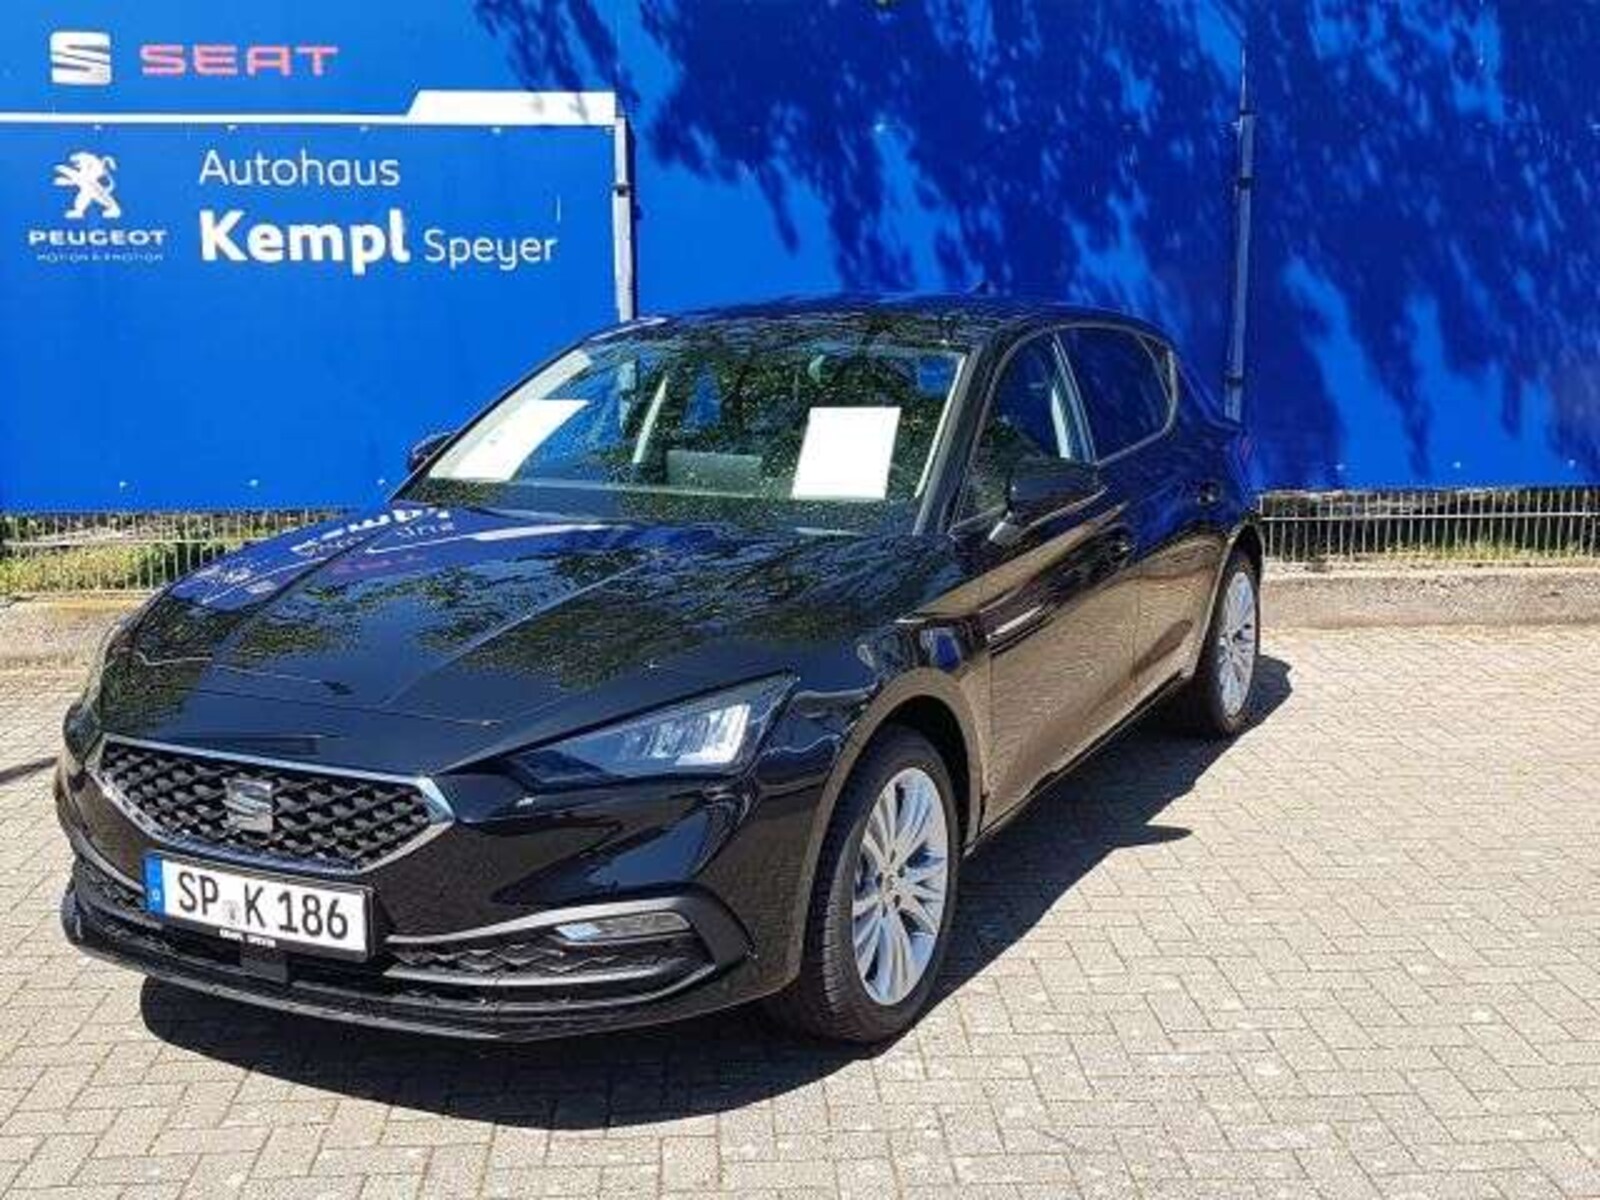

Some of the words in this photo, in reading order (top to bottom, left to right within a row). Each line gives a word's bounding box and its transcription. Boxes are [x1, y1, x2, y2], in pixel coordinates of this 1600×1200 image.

[140, 44, 338, 76] SEAT
[199, 149, 400, 187] Autohaus
[28, 229, 166, 246] PEUGEOT
[200, 208, 411, 275] Kempl
[423, 229, 558, 271] Speyer
[178, 871, 219, 916] SP
[244, 882, 266, 928] K
[277, 889, 348, 940] 186
